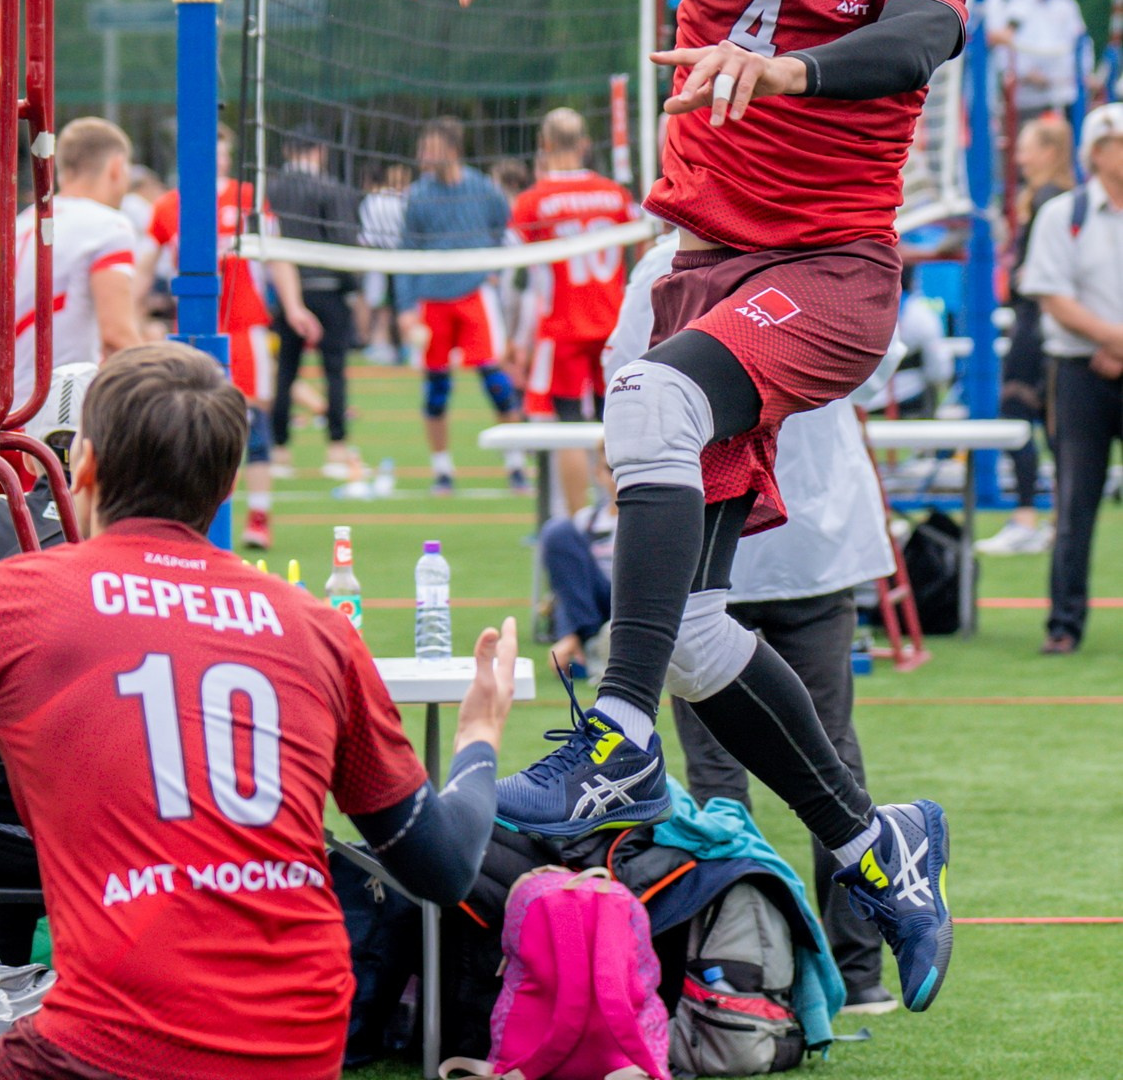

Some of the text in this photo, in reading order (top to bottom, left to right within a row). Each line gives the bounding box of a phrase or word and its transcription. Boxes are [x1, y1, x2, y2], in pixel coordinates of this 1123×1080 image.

[144, 552, 207, 571] ZASPORT
[91, 571, 284, 637] СЕРЕДА
[116, 652, 284, 827] 10
[103, 863, 176, 906] ДИТ
